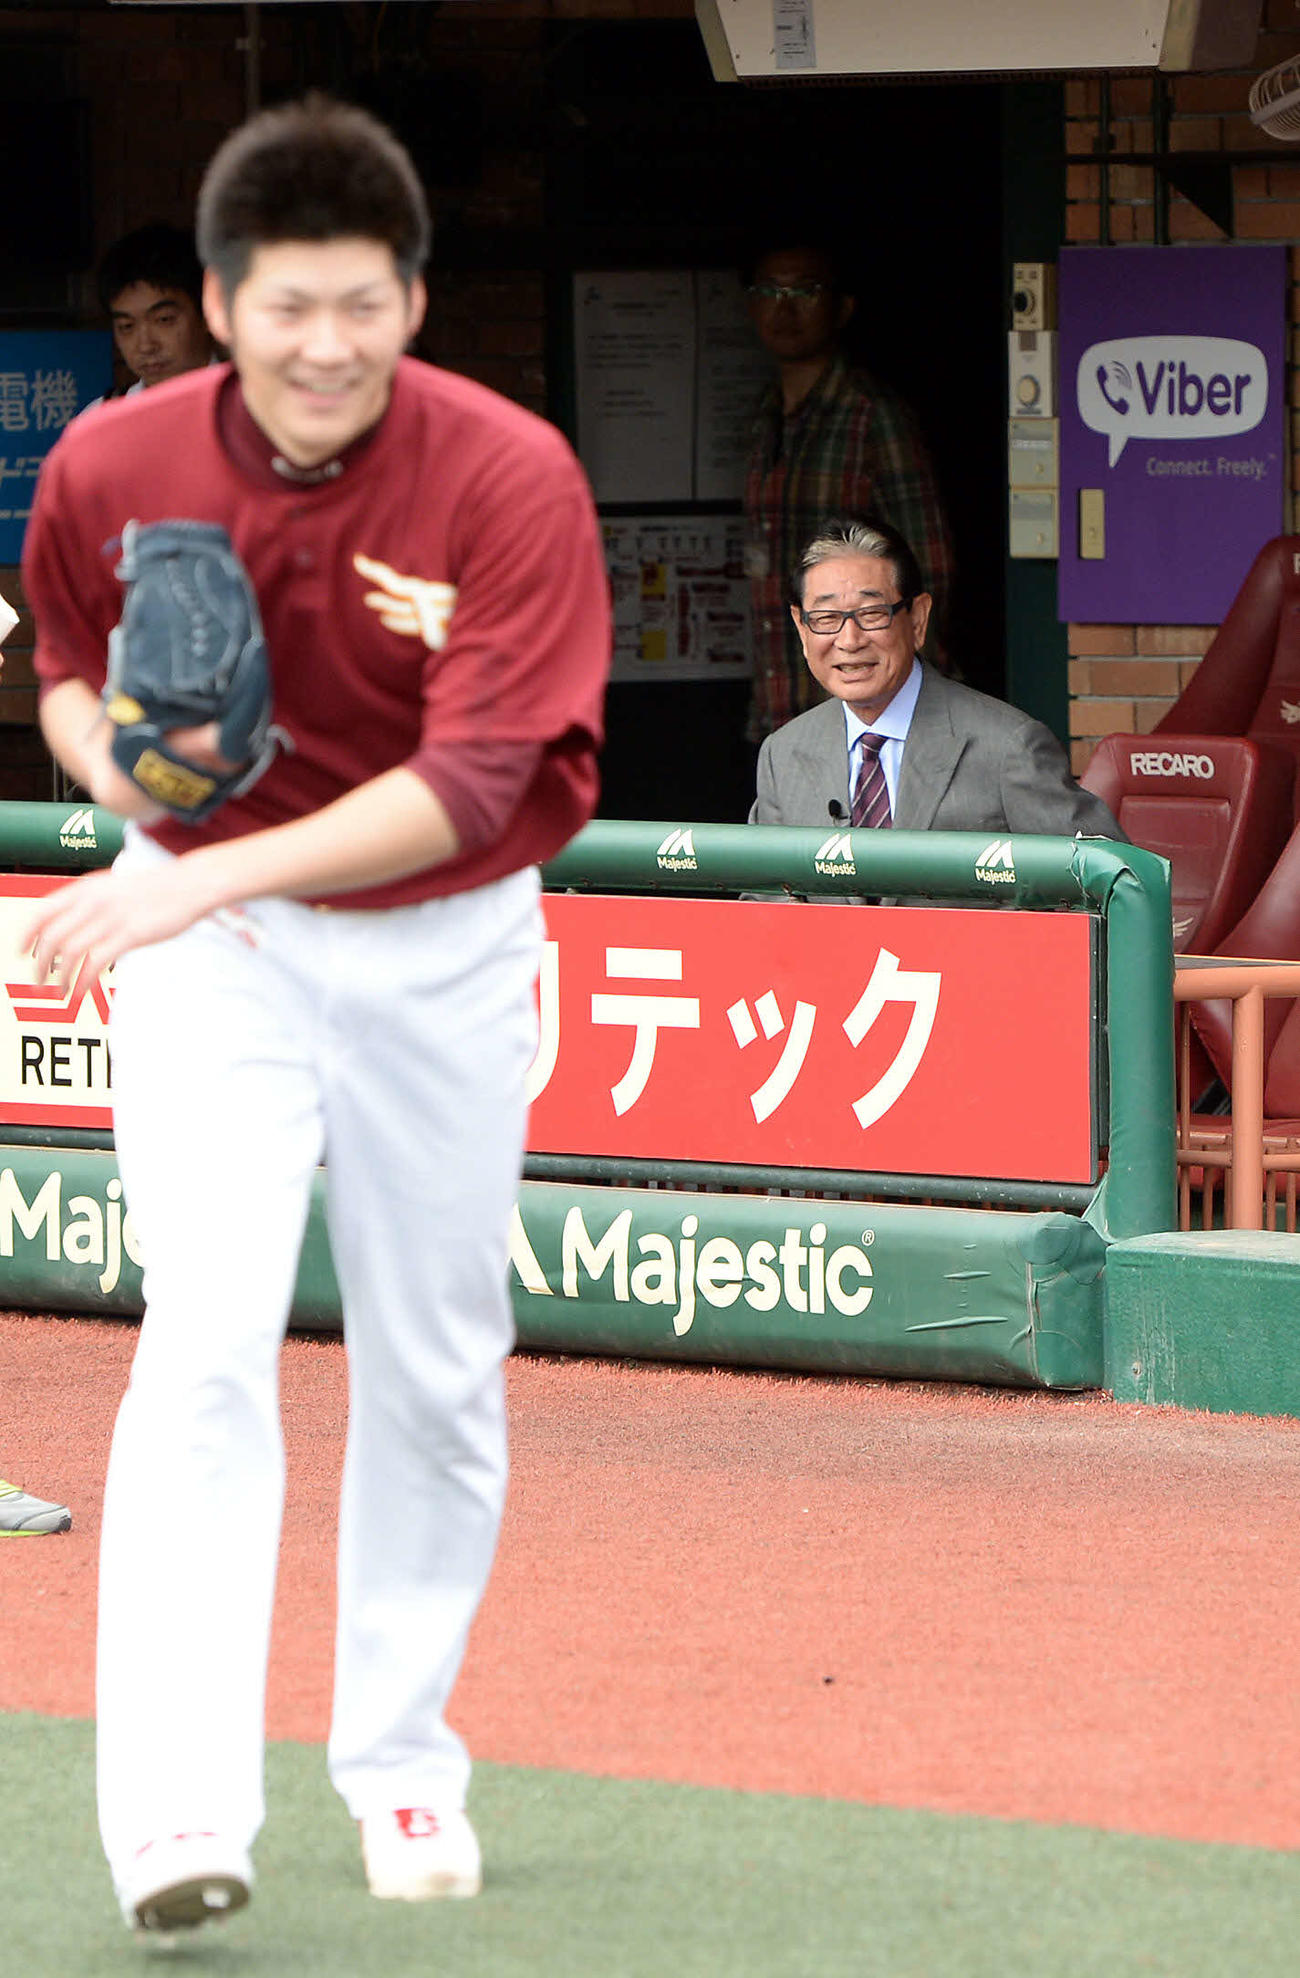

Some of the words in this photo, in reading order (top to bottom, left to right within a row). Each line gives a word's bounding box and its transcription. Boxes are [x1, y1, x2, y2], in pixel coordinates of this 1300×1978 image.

[1136, 361, 1251, 415] Viber
[1146, 457, 1213, 477] Connect.
[1130, 752, 1215, 779] RECARO
[656, 856, 698, 872] Majestic
[814, 861, 857, 877] Majestic
[974, 867, 1016, 885] Majestic
